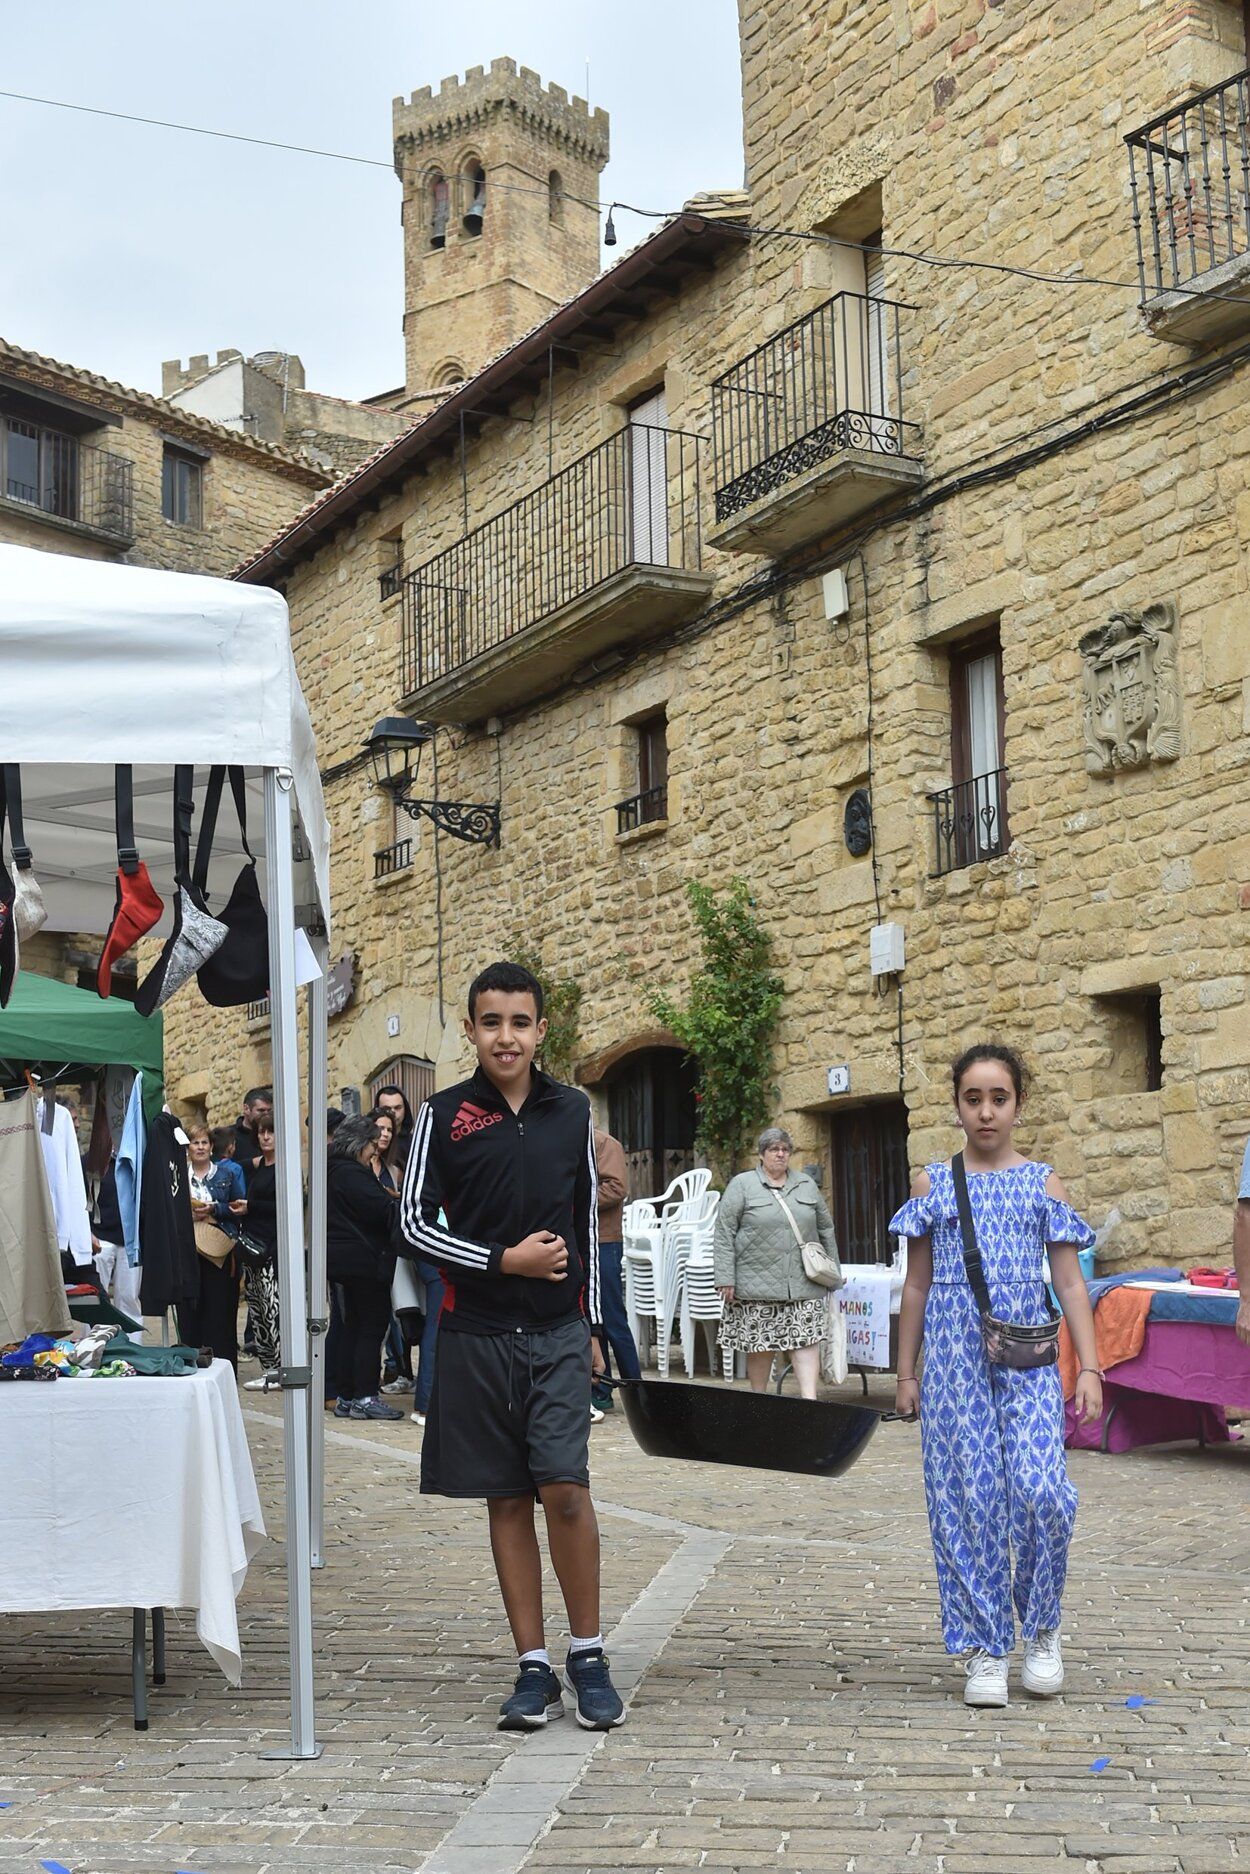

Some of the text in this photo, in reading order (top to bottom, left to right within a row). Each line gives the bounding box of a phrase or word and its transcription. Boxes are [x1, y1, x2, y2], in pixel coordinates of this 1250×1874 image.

[834, 1073, 841, 1085] 3
[451, 1112, 503, 1141] adidas
[839, 1300, 873, 1317] MANOS
